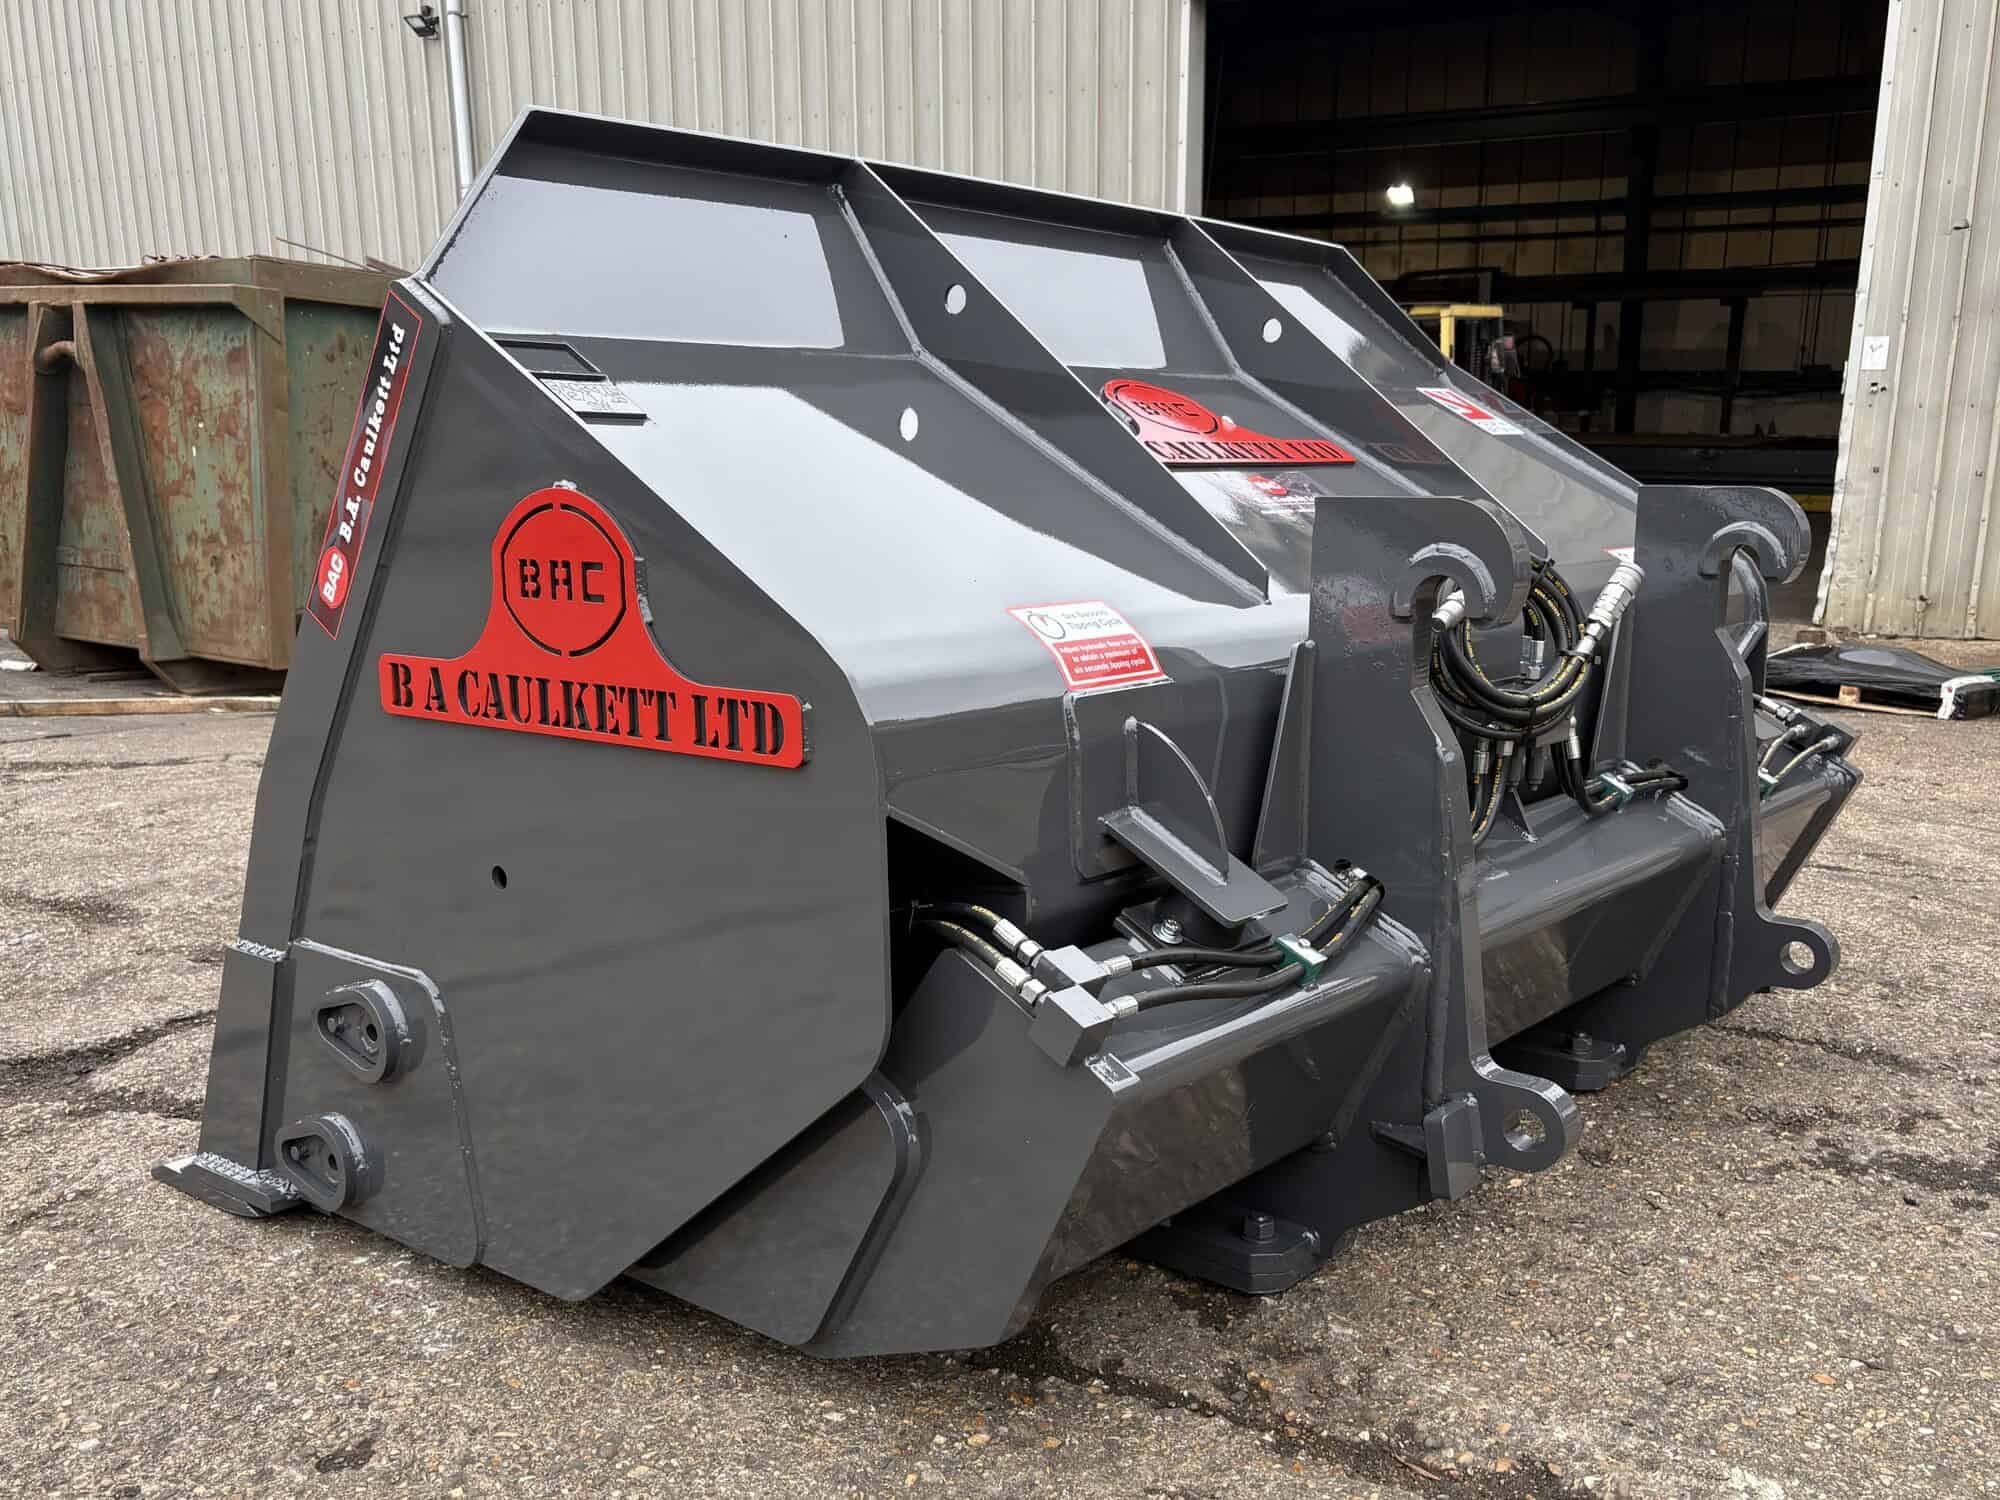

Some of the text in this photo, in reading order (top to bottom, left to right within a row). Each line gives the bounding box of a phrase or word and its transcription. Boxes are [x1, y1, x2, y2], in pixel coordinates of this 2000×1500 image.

[338, 322, 406, 544] B.A. Caulkett Ltd
[1144, 441, 1344, 459] CAULKETT LTD
[322, 553, 345, 603] BAC
[387, 660, 785, 757] B A CAULKETT LTD
